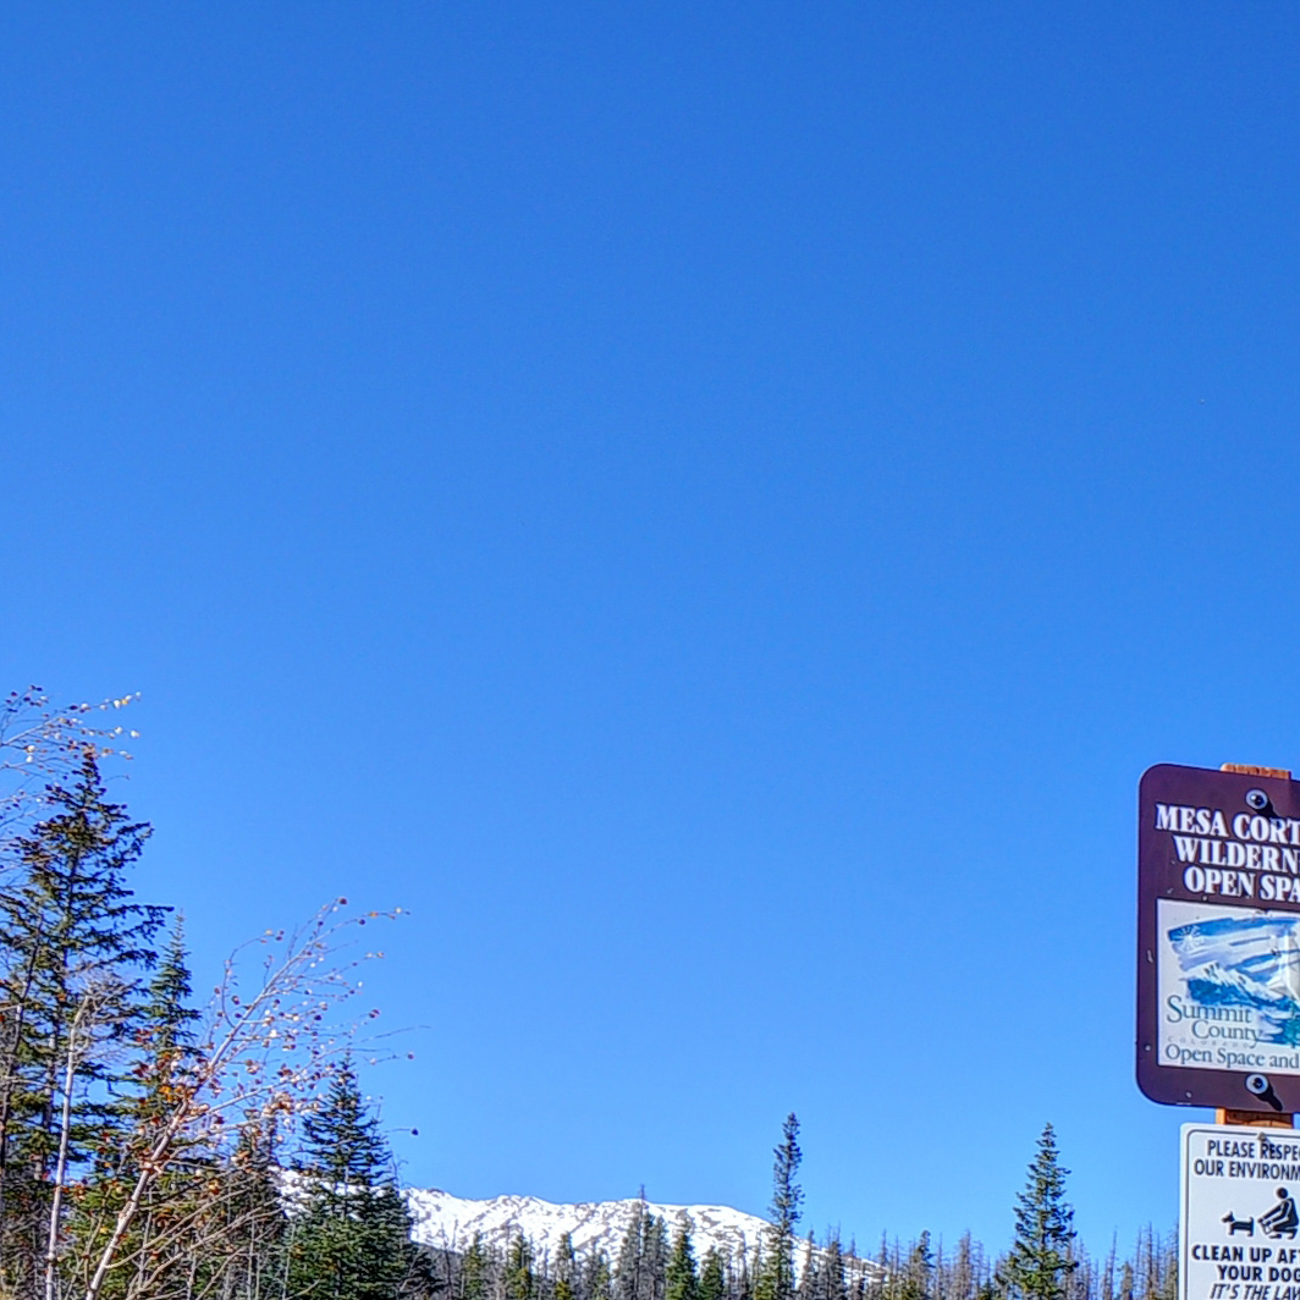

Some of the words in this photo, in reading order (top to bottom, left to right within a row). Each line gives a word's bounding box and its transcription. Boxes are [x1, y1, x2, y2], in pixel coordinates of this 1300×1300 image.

[1155, 804, 1229, 838] MESA
[1184, 866, 1255, 898] OPEN
[1166, 995, 1251, 1023] Summit
[1192, 1021, 1263, 1048] County
[1165, 1044, 1212, 1064] Open
[1217, 1048, 1265, 1069] Space
[1269, 1051, 1299, 1069] and
[1207, 1140, 1255, 1159] PLEASE
[1194, 1159, 1224, 1177] OUR
[1192, 1245, 1244, 1262] CLEAN
[1250, 1247, 1272, 1263] UP
[1218, 1265, 1262, 1282] YOUR
[1210, 1283, 1240, 1300] IT'S
[1244, 1285, 1271, 1300] THE
